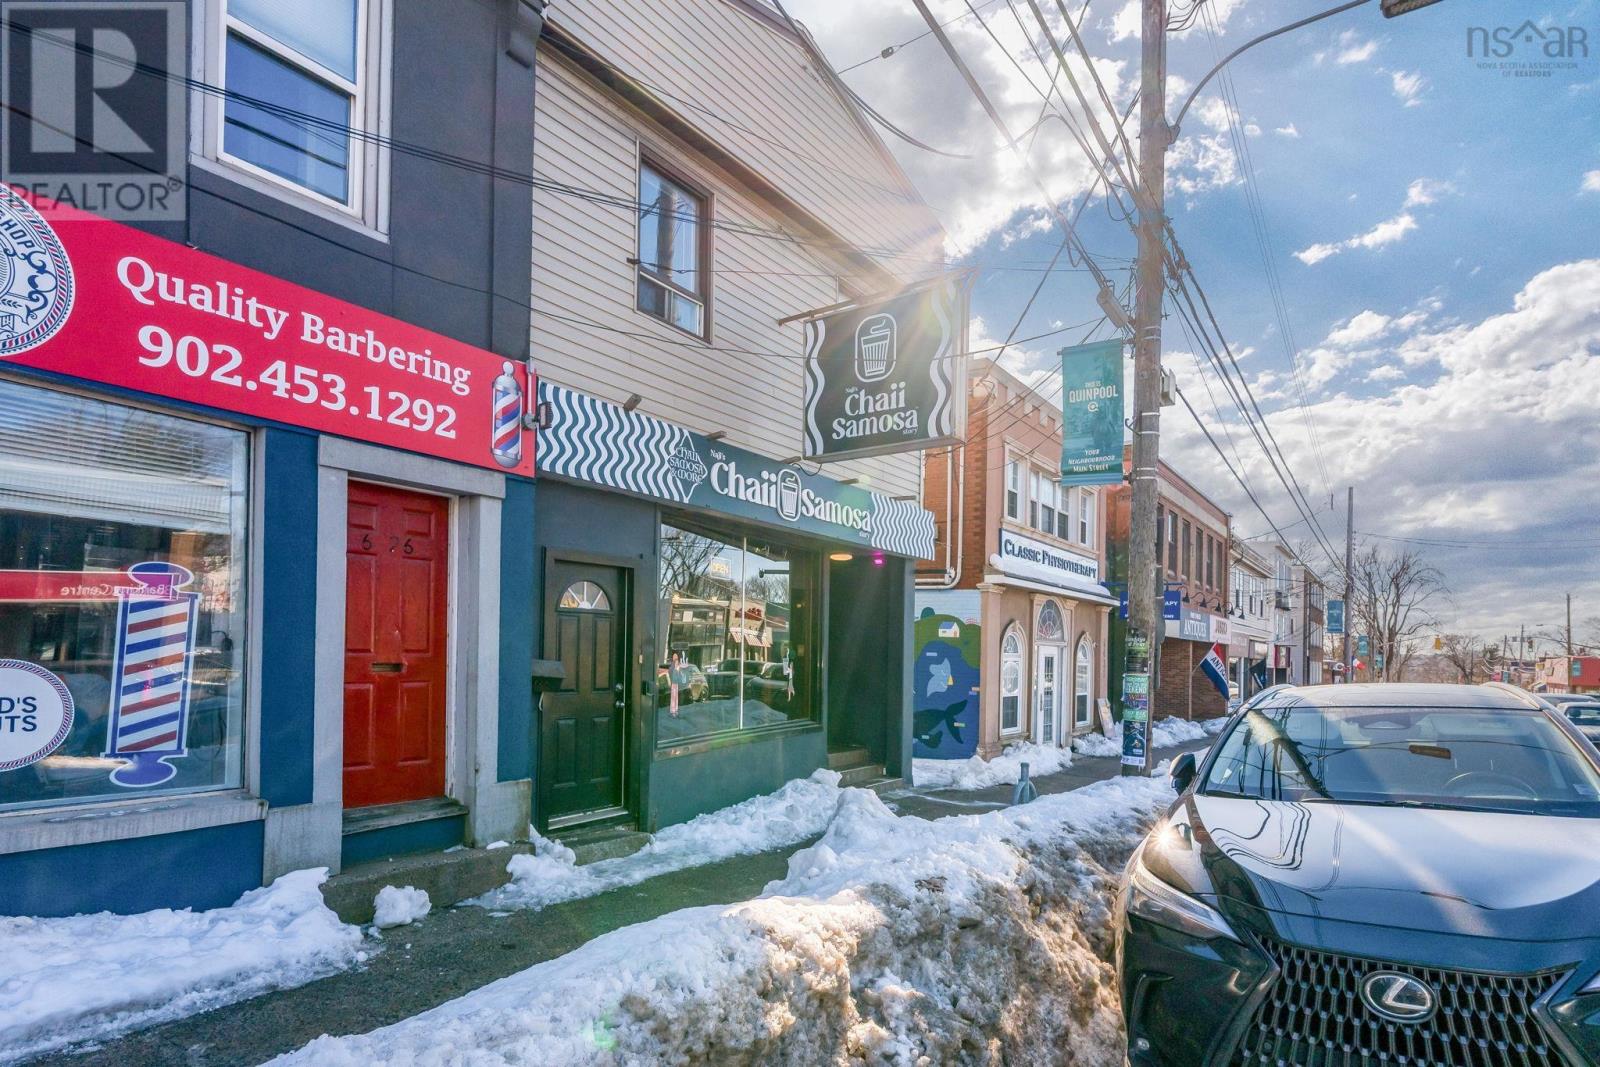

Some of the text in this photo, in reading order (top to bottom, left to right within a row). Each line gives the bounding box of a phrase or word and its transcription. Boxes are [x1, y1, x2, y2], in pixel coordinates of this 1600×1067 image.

[117, 256, 472, 396] Quality Barbering
[138, 325, 457, 439] 902.453.1292
[845, 381, 906, 416] Chaii
[1069, 385, 1119, 403] QUINPOOL
[710, 461, 777, 509] Chaii
[1183, 618, 1207, 640] ANTIQUES
